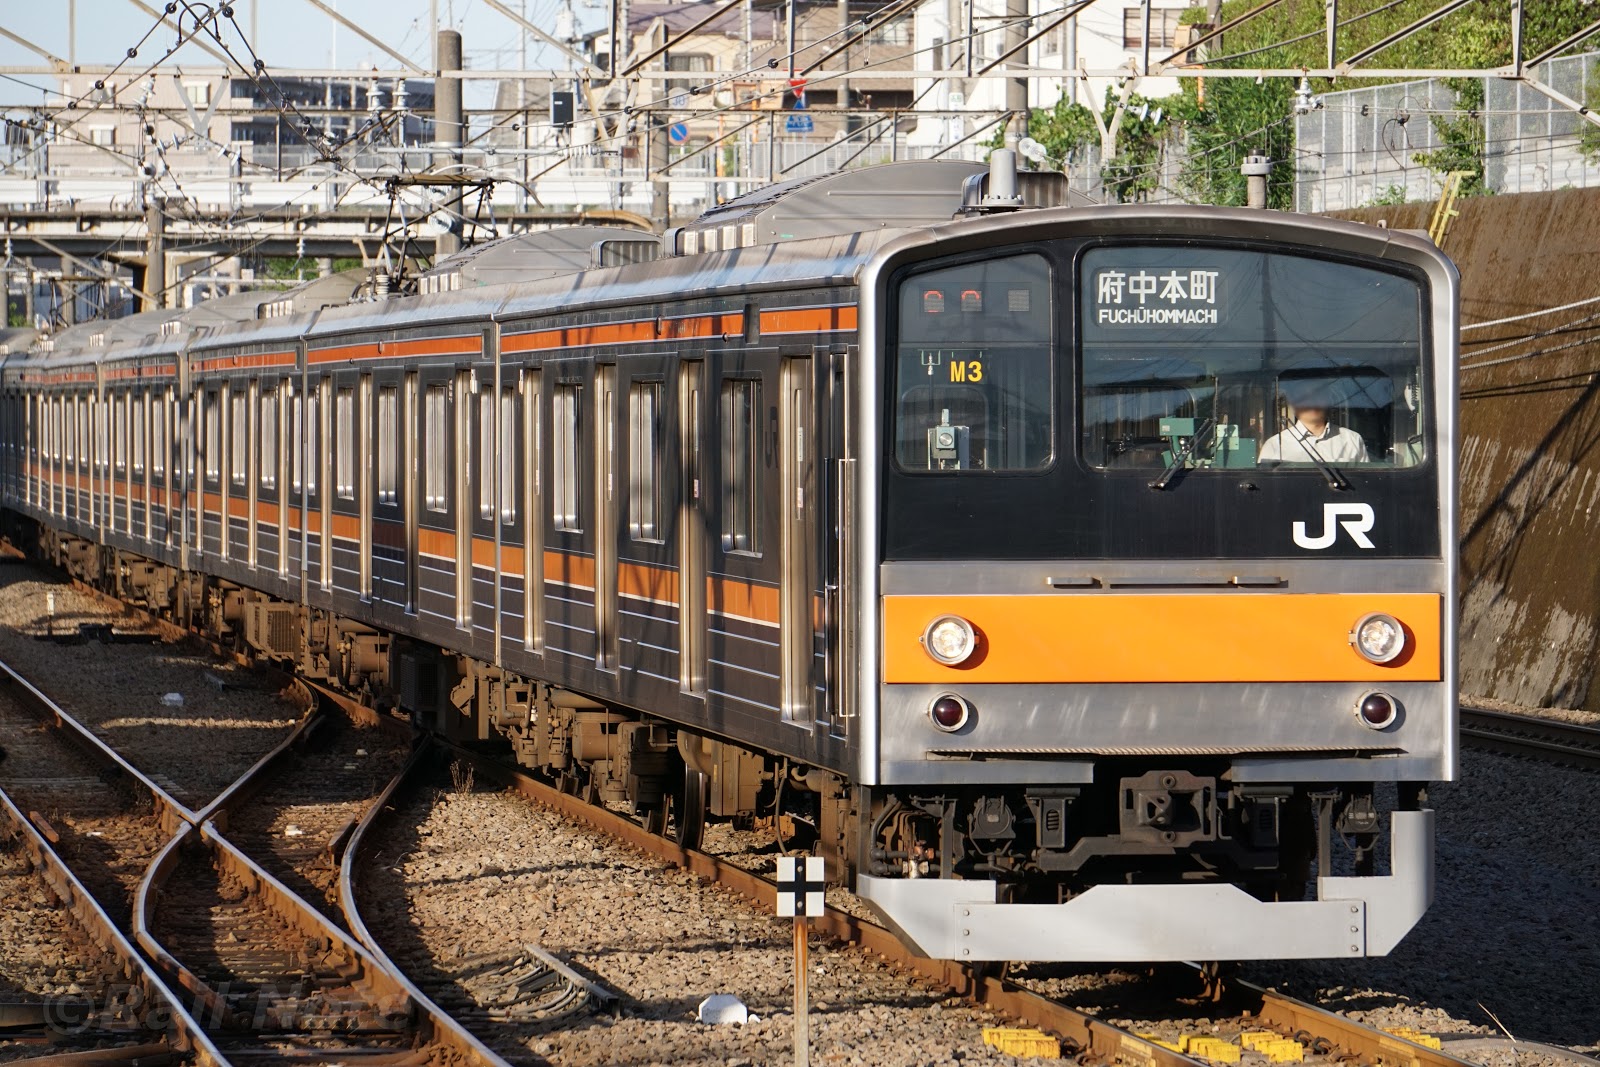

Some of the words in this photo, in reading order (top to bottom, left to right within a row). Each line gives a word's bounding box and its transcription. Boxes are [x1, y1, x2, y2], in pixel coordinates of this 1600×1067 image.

[1098, 270, 1219, 304] 府中本町
[950, 360, 983, 383] M3
[1293, 503, 1376, 550] JR
